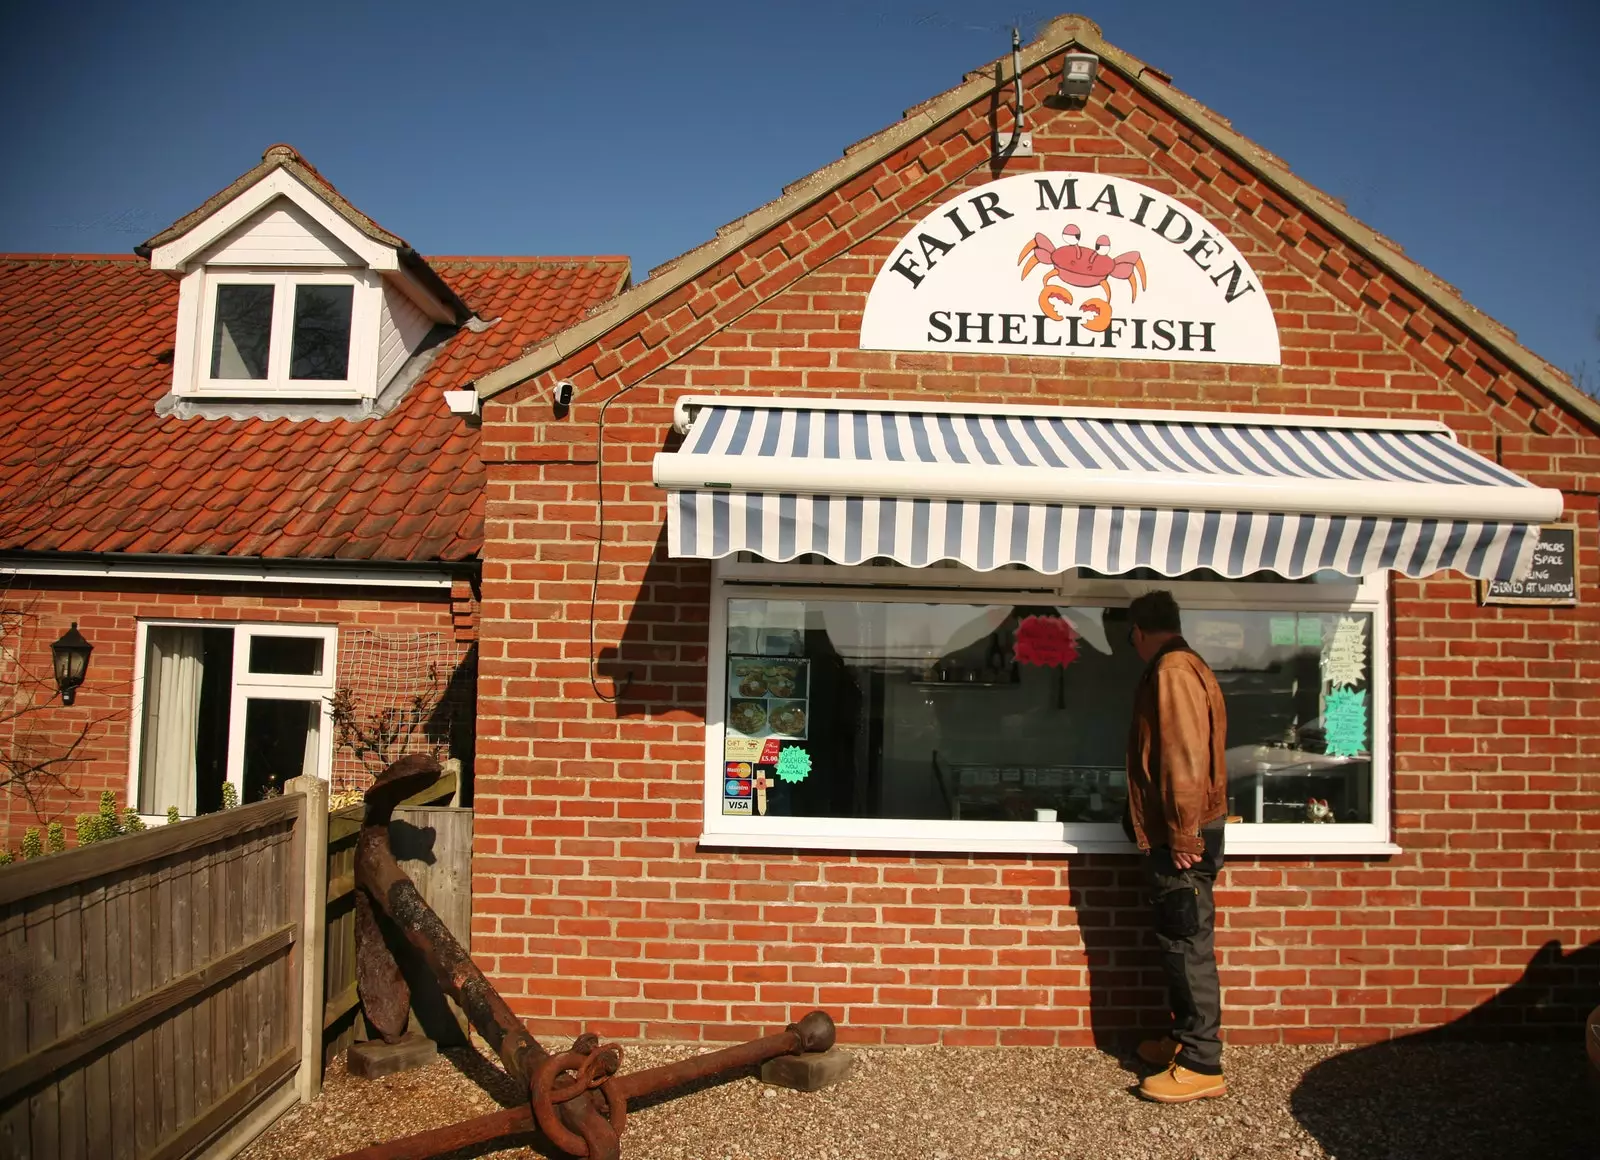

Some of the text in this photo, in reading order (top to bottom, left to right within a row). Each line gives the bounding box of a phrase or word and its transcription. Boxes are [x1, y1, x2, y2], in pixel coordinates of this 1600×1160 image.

[889, 178, 1256, 304] FAIR MAIDEN
[926, 310, 1217, 353] SHELLFISH
[1533, 554, 1564, 565] SPACE
[1492, 582, 1523, 594] SERVED
[1526, 582, 1537, 593] AT
[728, 801, 749, 809] VISA
